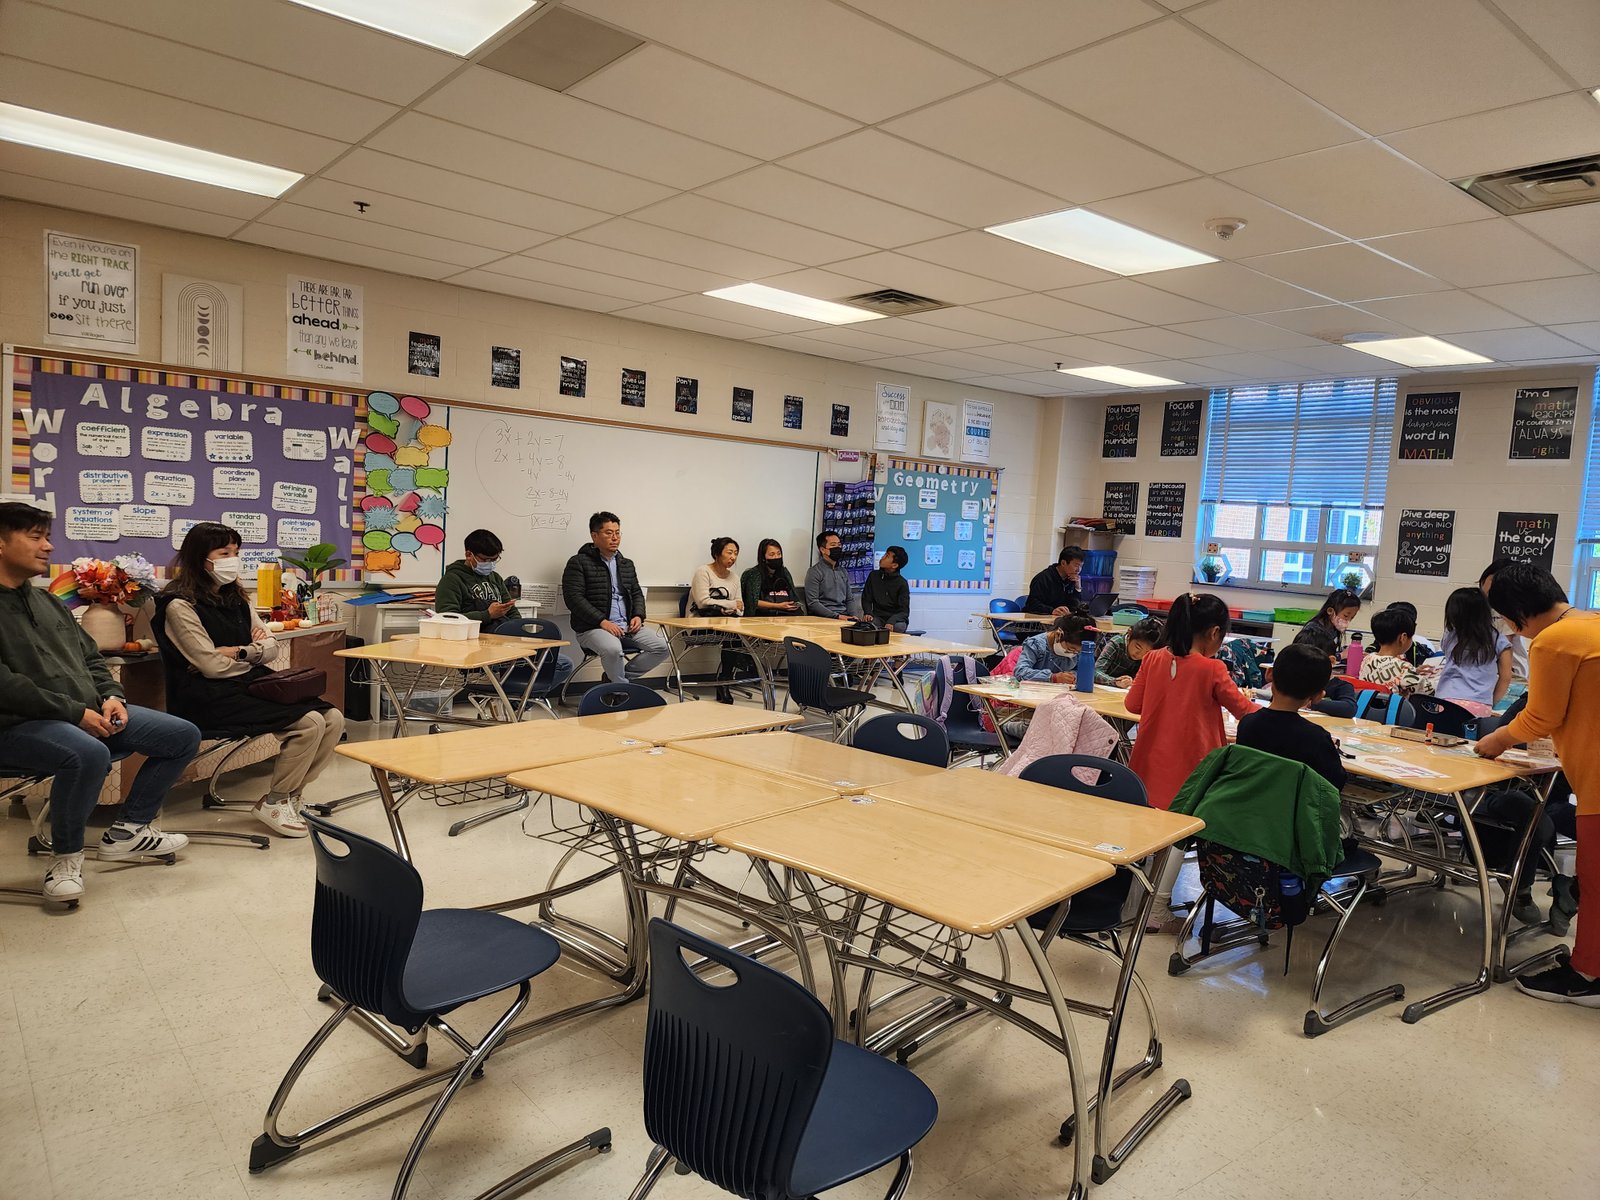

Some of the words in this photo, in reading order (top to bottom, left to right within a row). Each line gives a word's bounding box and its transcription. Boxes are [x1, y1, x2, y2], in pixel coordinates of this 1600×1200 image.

[52, 237, 77, 248] Even
[50, 249, 68, 260] the
[71, 252, 99, 266] RIGHT
[84, 269, 102, 279] get
[81, 280, 100, 295] run
[104, 284, 128, 298] over
[299, 280, 317, 294] THERE
[318, 284, 329, 296] ARE
[342, 288, 353, 300] FAR
[58, 294, 69, 306] if
[72, 298, 96, 310] you
[98, 300, 126, 314] just
[328, 336, 340, 348] we
[342, 336, 358, 350] leave
[313, 350, 359, 365] behind.
[413, 360, 436, 369] ABOVE
[562, 381, 579, 389] mind
[676, 377, 692, 386] Don't
[882, 385, 906, 400] Success
[1516, 389, 1539, 399] I'm
[1542, 390, 1550, 398] a
[80, 383, 283, 426] Algebra
[1168, 401, 1195, 410] Focus
[1411, 396, 1454, 406] OBVIOUS
[1534, 400, 1570, 410] math
[834, 404, 847, 412] Keep
[1107, 406, 1120, 417] You
[1120, 405, 1140, 413] have
[1405, 408, 1413, 416] is
[1414, 407, 1430, 416] the
[1431, 406, 1458, 415] most
[81, 425, 126, 434] coefficient
[1112, 422, 1130, 431] odd
[1406, 419, 1453, 431] dangerous
[147, 429, 188, 439] expression
[496, 428, 512, 444] 3x
[1404, 430, 1436, 441] word
[1438, 431, 1450, 440] in
[1519, 427, 1564, 440] ALWAYS
[1104, 437, 1138, 445] number
[494, 448, 508, 463] 2x
[154, 474, 187, 482] equation
[327, 426, 361, 529] Wall
[280, 484, 307, 493] defining
[893, 471, 980, 496] Geometry
[1106, 491, 1123, 499] lines
[72, 508, 102, 516] system
[132, 506, 156, 515] slope
[1403, 510, 1422, 519] Dive
[1424, 510, 1450, 521] deep
[1516, 519, 1551, 529] math
[1406, 531, 1445, 540] anything
[1499, 531, 1520, 543] the
[1524, 533, 1554, 549] only
[1399, 541, 1412, 557] &
[1413, 545, 1433, 555] you
[1435, 544, 1450, 553] will
